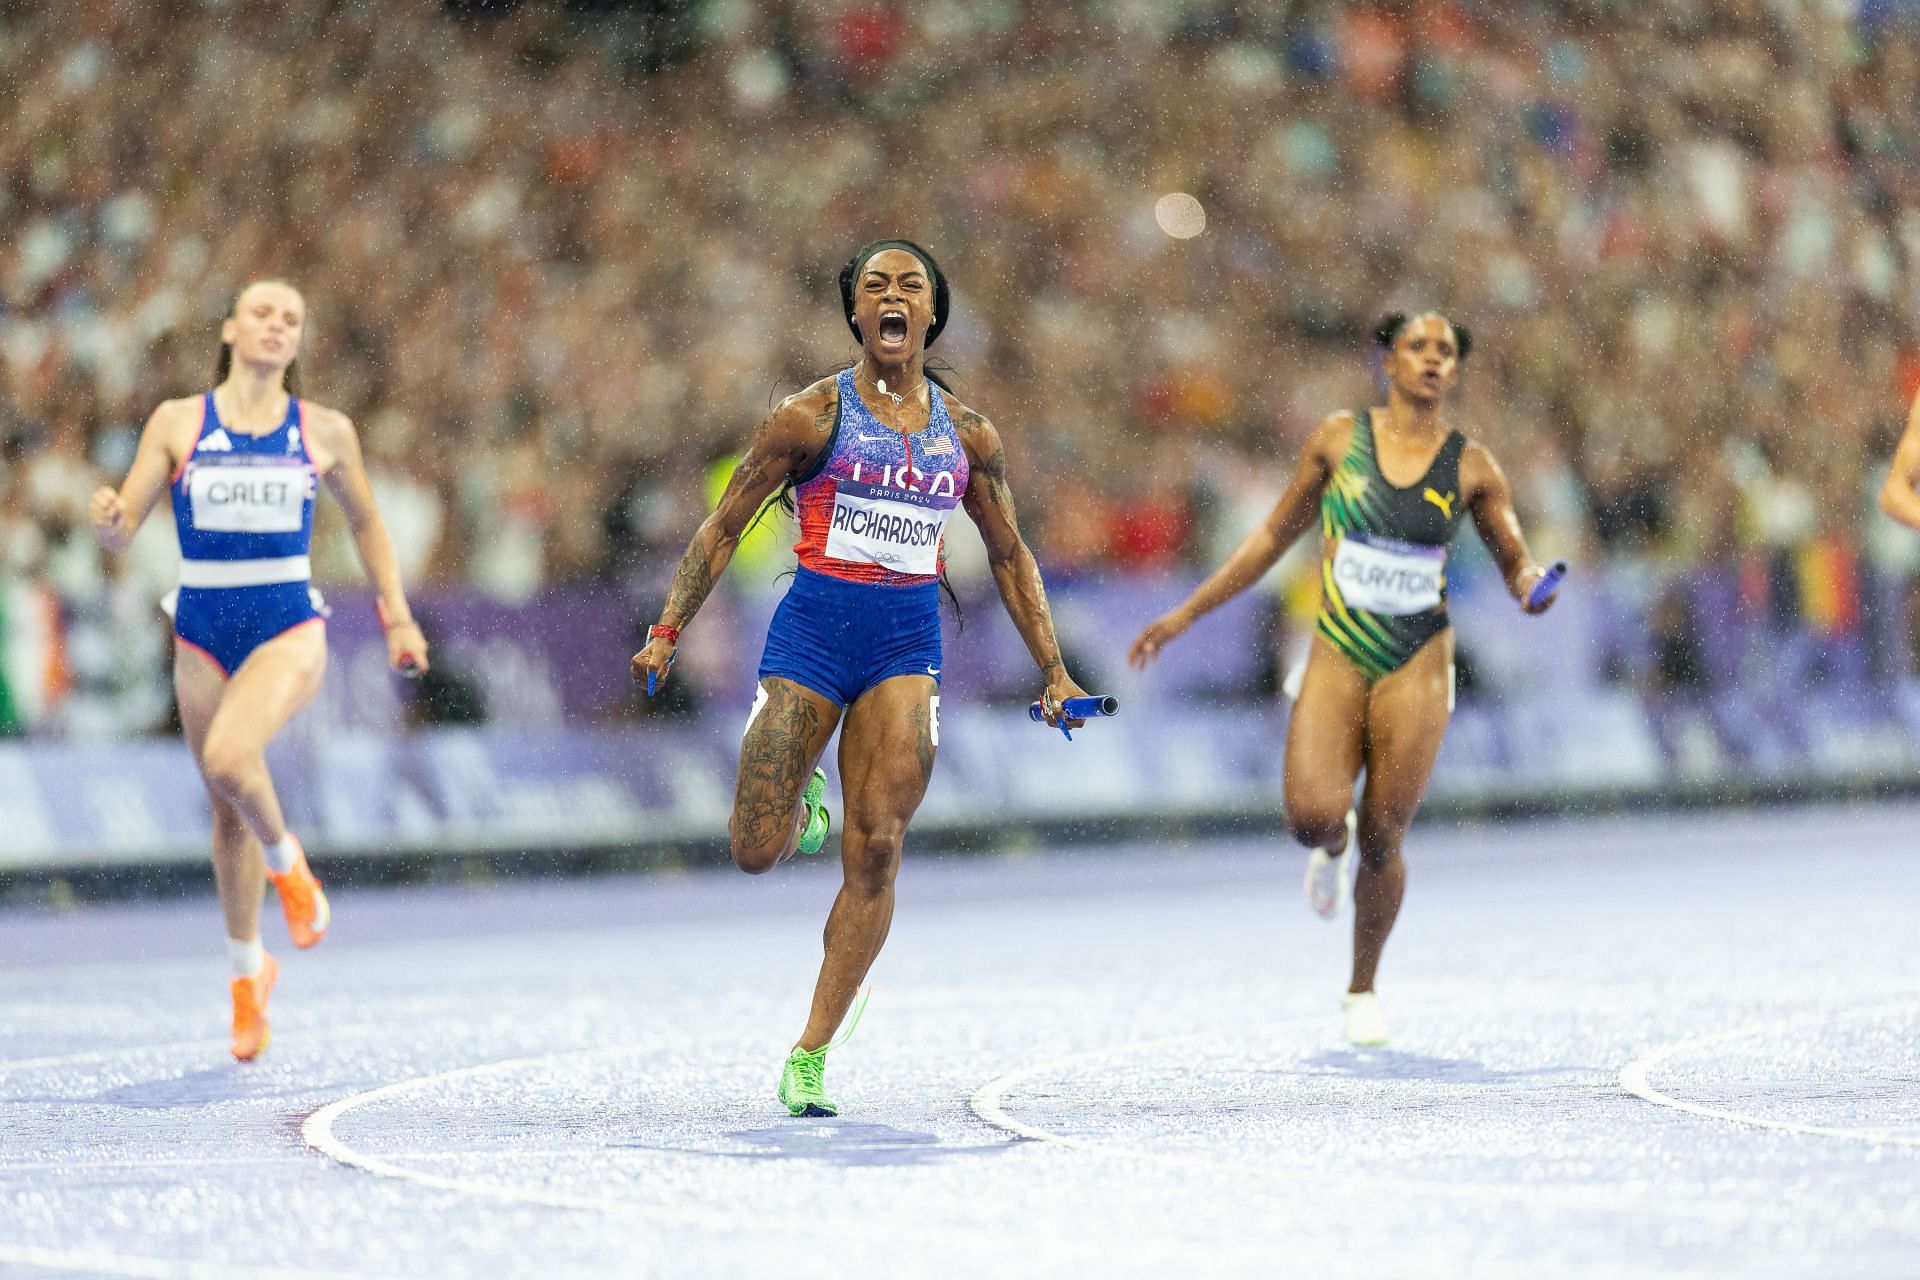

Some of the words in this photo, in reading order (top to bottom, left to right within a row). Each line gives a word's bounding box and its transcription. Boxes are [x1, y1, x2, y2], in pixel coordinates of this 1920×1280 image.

[208, 481, 289, 505] CALET
[869, 488, 901, 499] PARIS
[903, 493, 931, 504] 2024
[832, 503, 942, 547] RICHARDSON
[1339, 557, 1437, 594] CLAYTON
